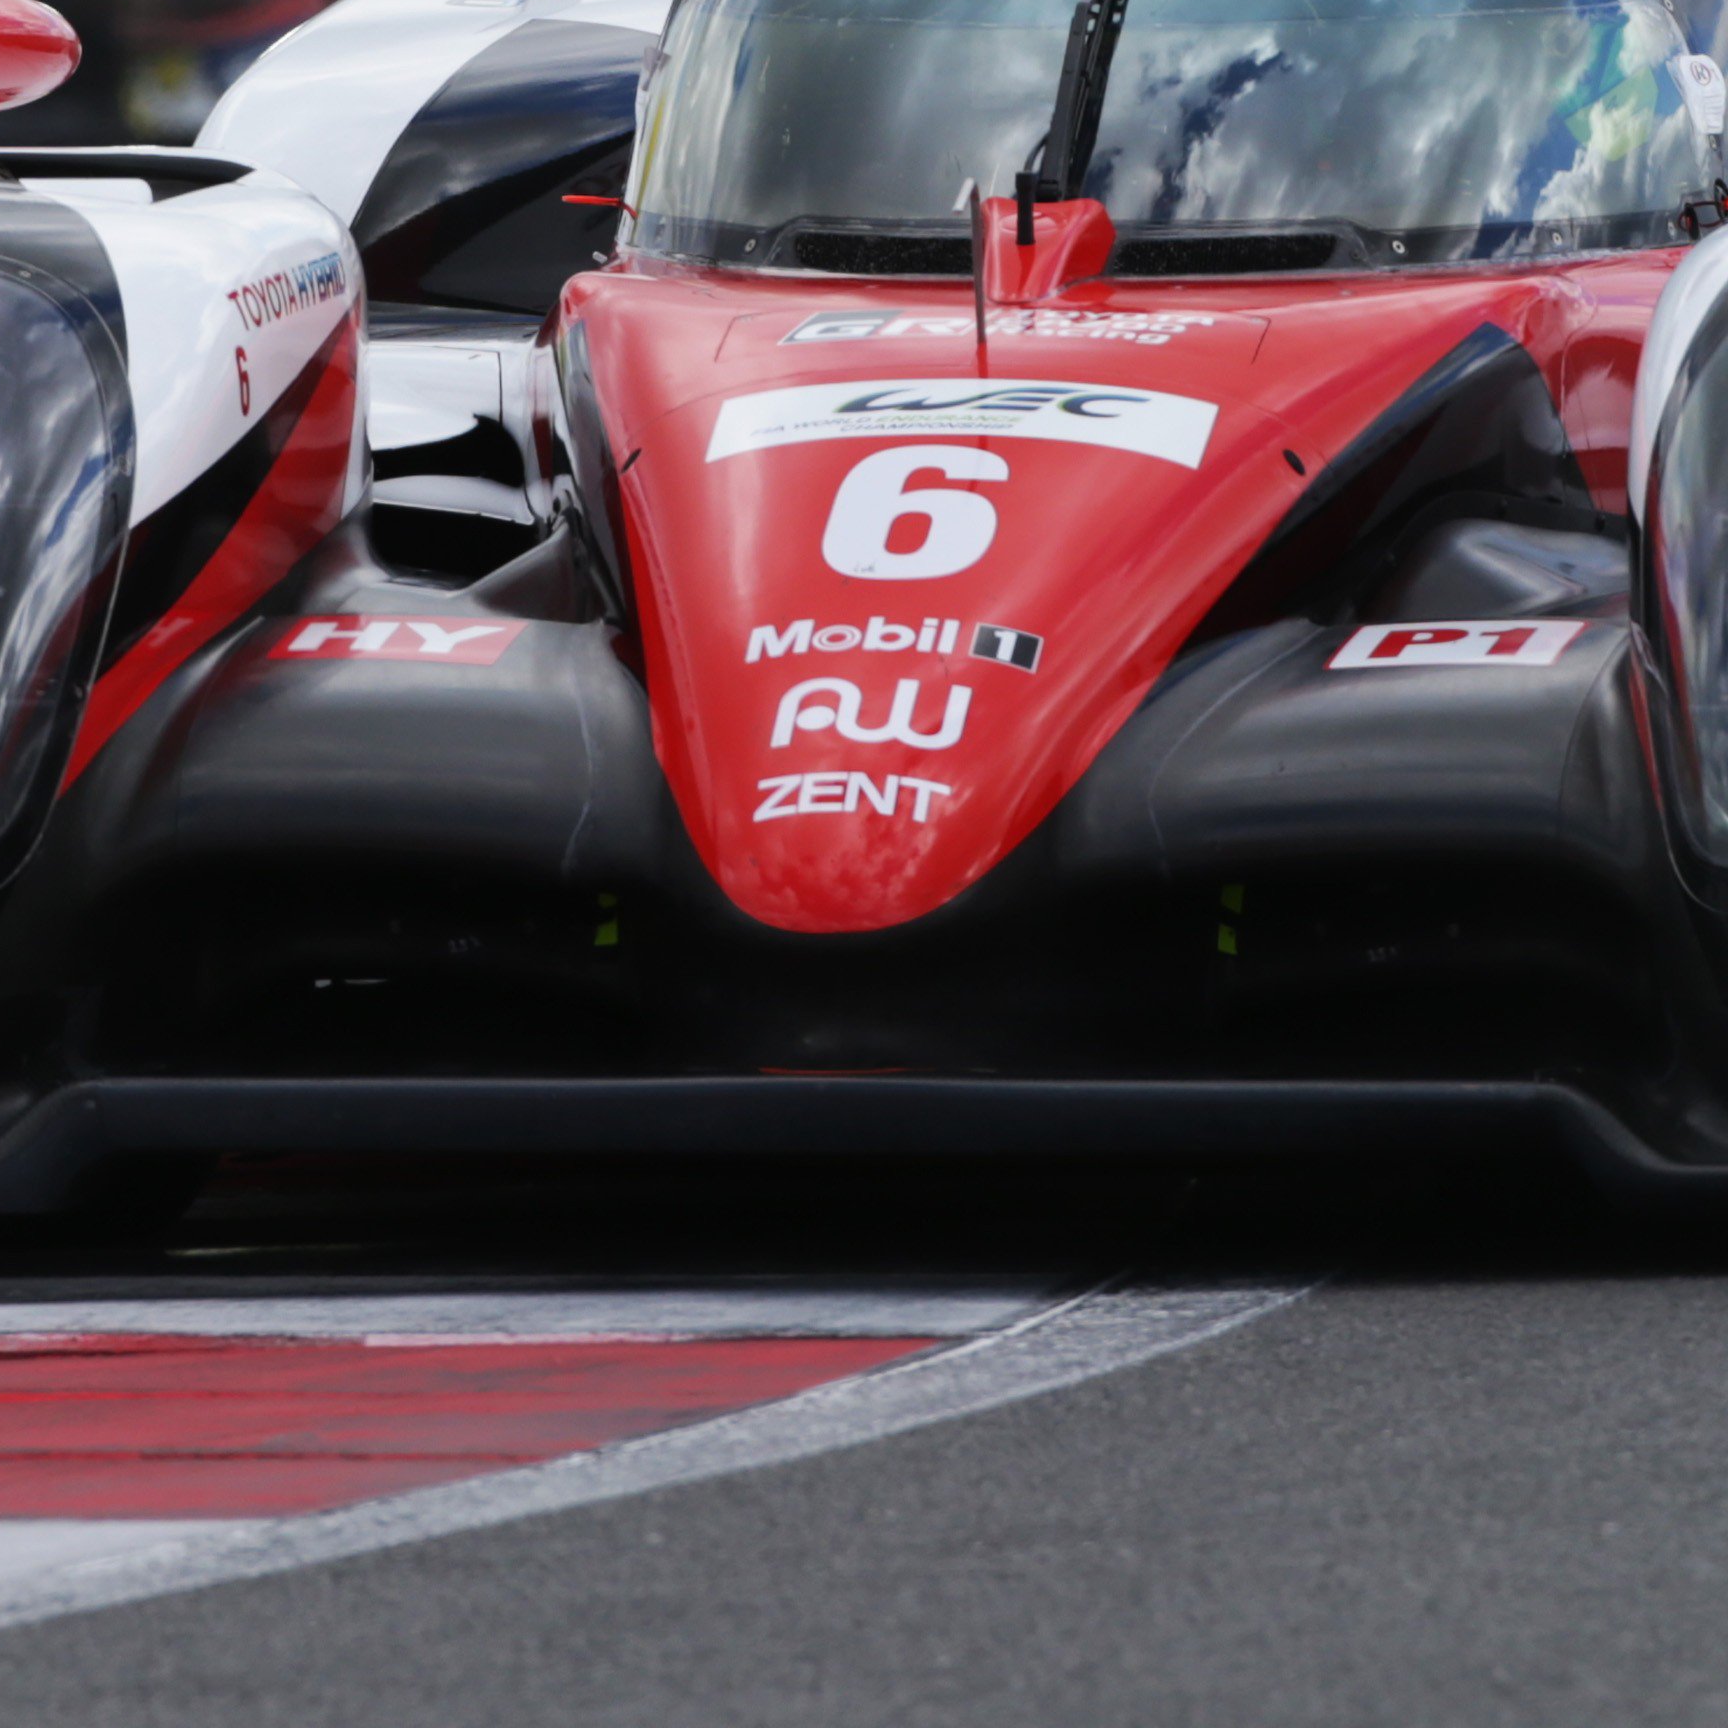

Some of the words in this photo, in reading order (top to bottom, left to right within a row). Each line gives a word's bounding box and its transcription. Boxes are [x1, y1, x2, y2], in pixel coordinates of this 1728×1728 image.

[227, 270, 298, 331] TOYOTA
[234, 345, 251, 417] 6
[820, 443, 1010, 581] 6
[287, 621, 508, 654] HY
[744, 616, 961, 665] Mobil
[1367, 627, 1539, 660] P1
[752, 770, 952, 824] ZENT
